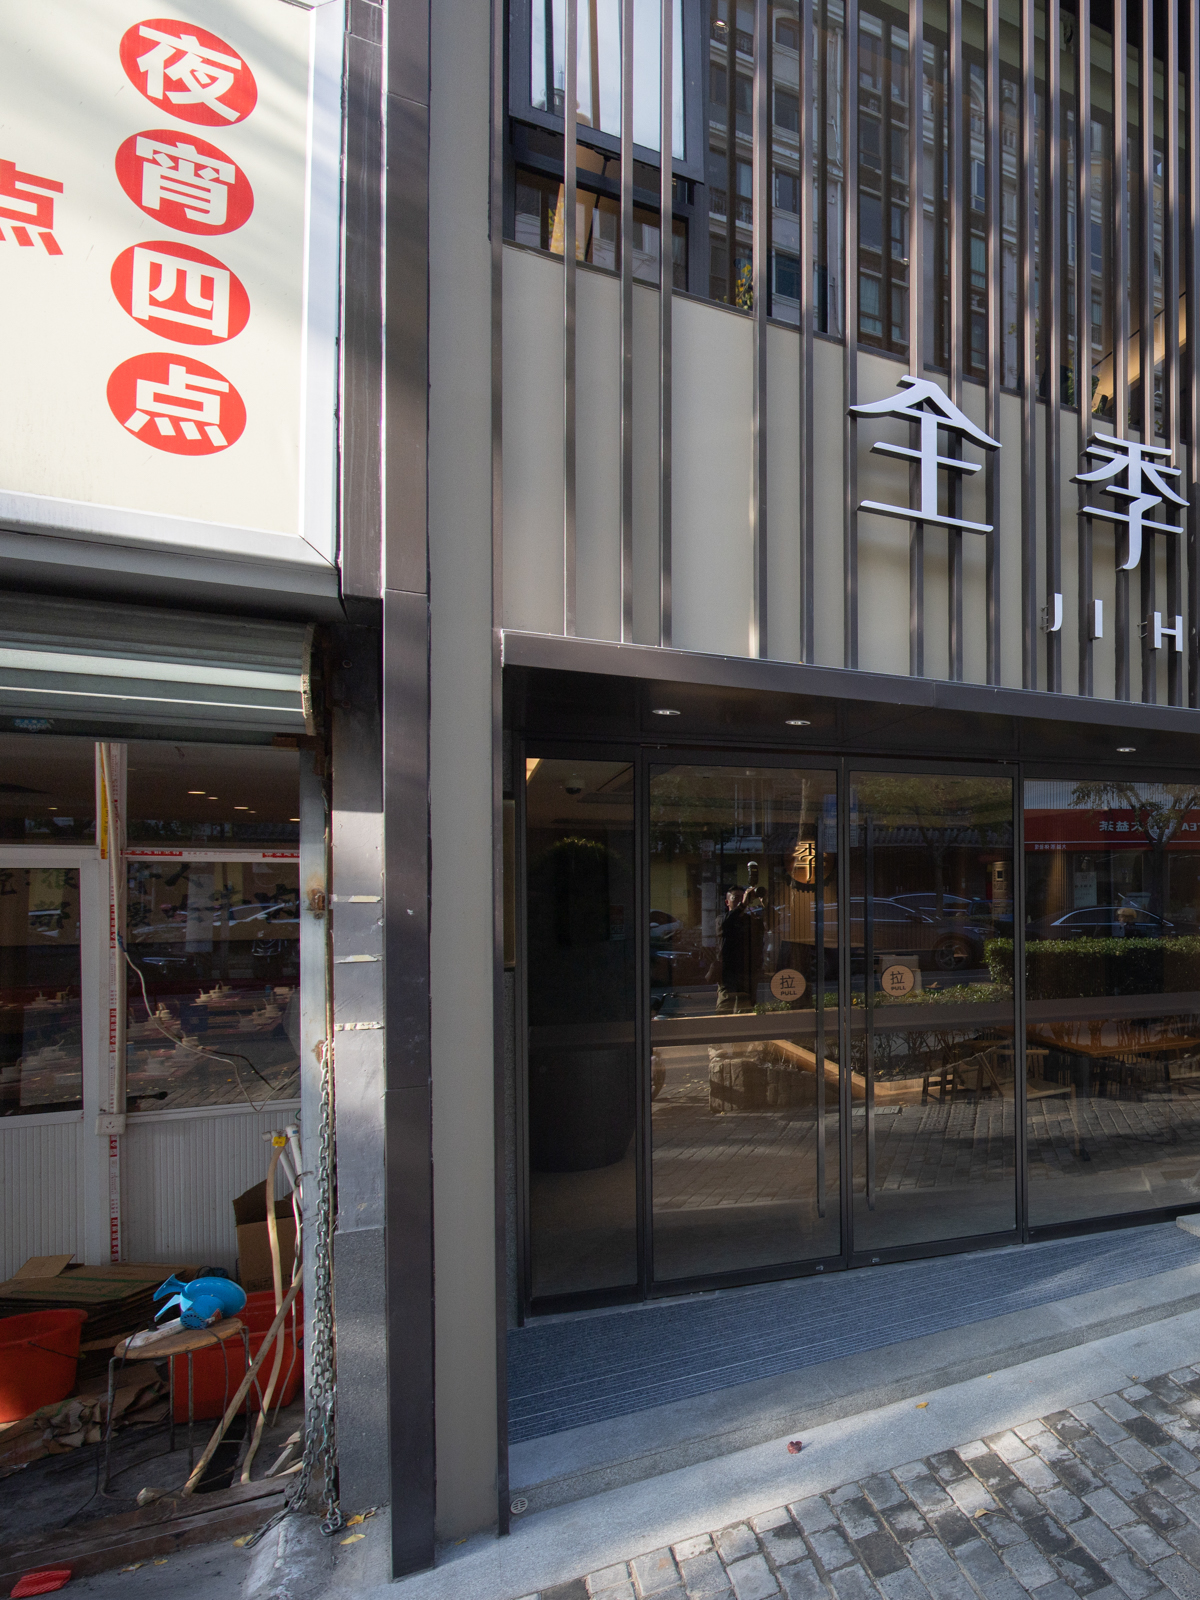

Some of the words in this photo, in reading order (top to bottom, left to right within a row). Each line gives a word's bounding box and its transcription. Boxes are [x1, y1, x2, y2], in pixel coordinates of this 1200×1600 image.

[124, 25, 242, 446] 夜宵四点
[780, 975, 795, 988] 拉
[890, 971, 905, 984] 拉
